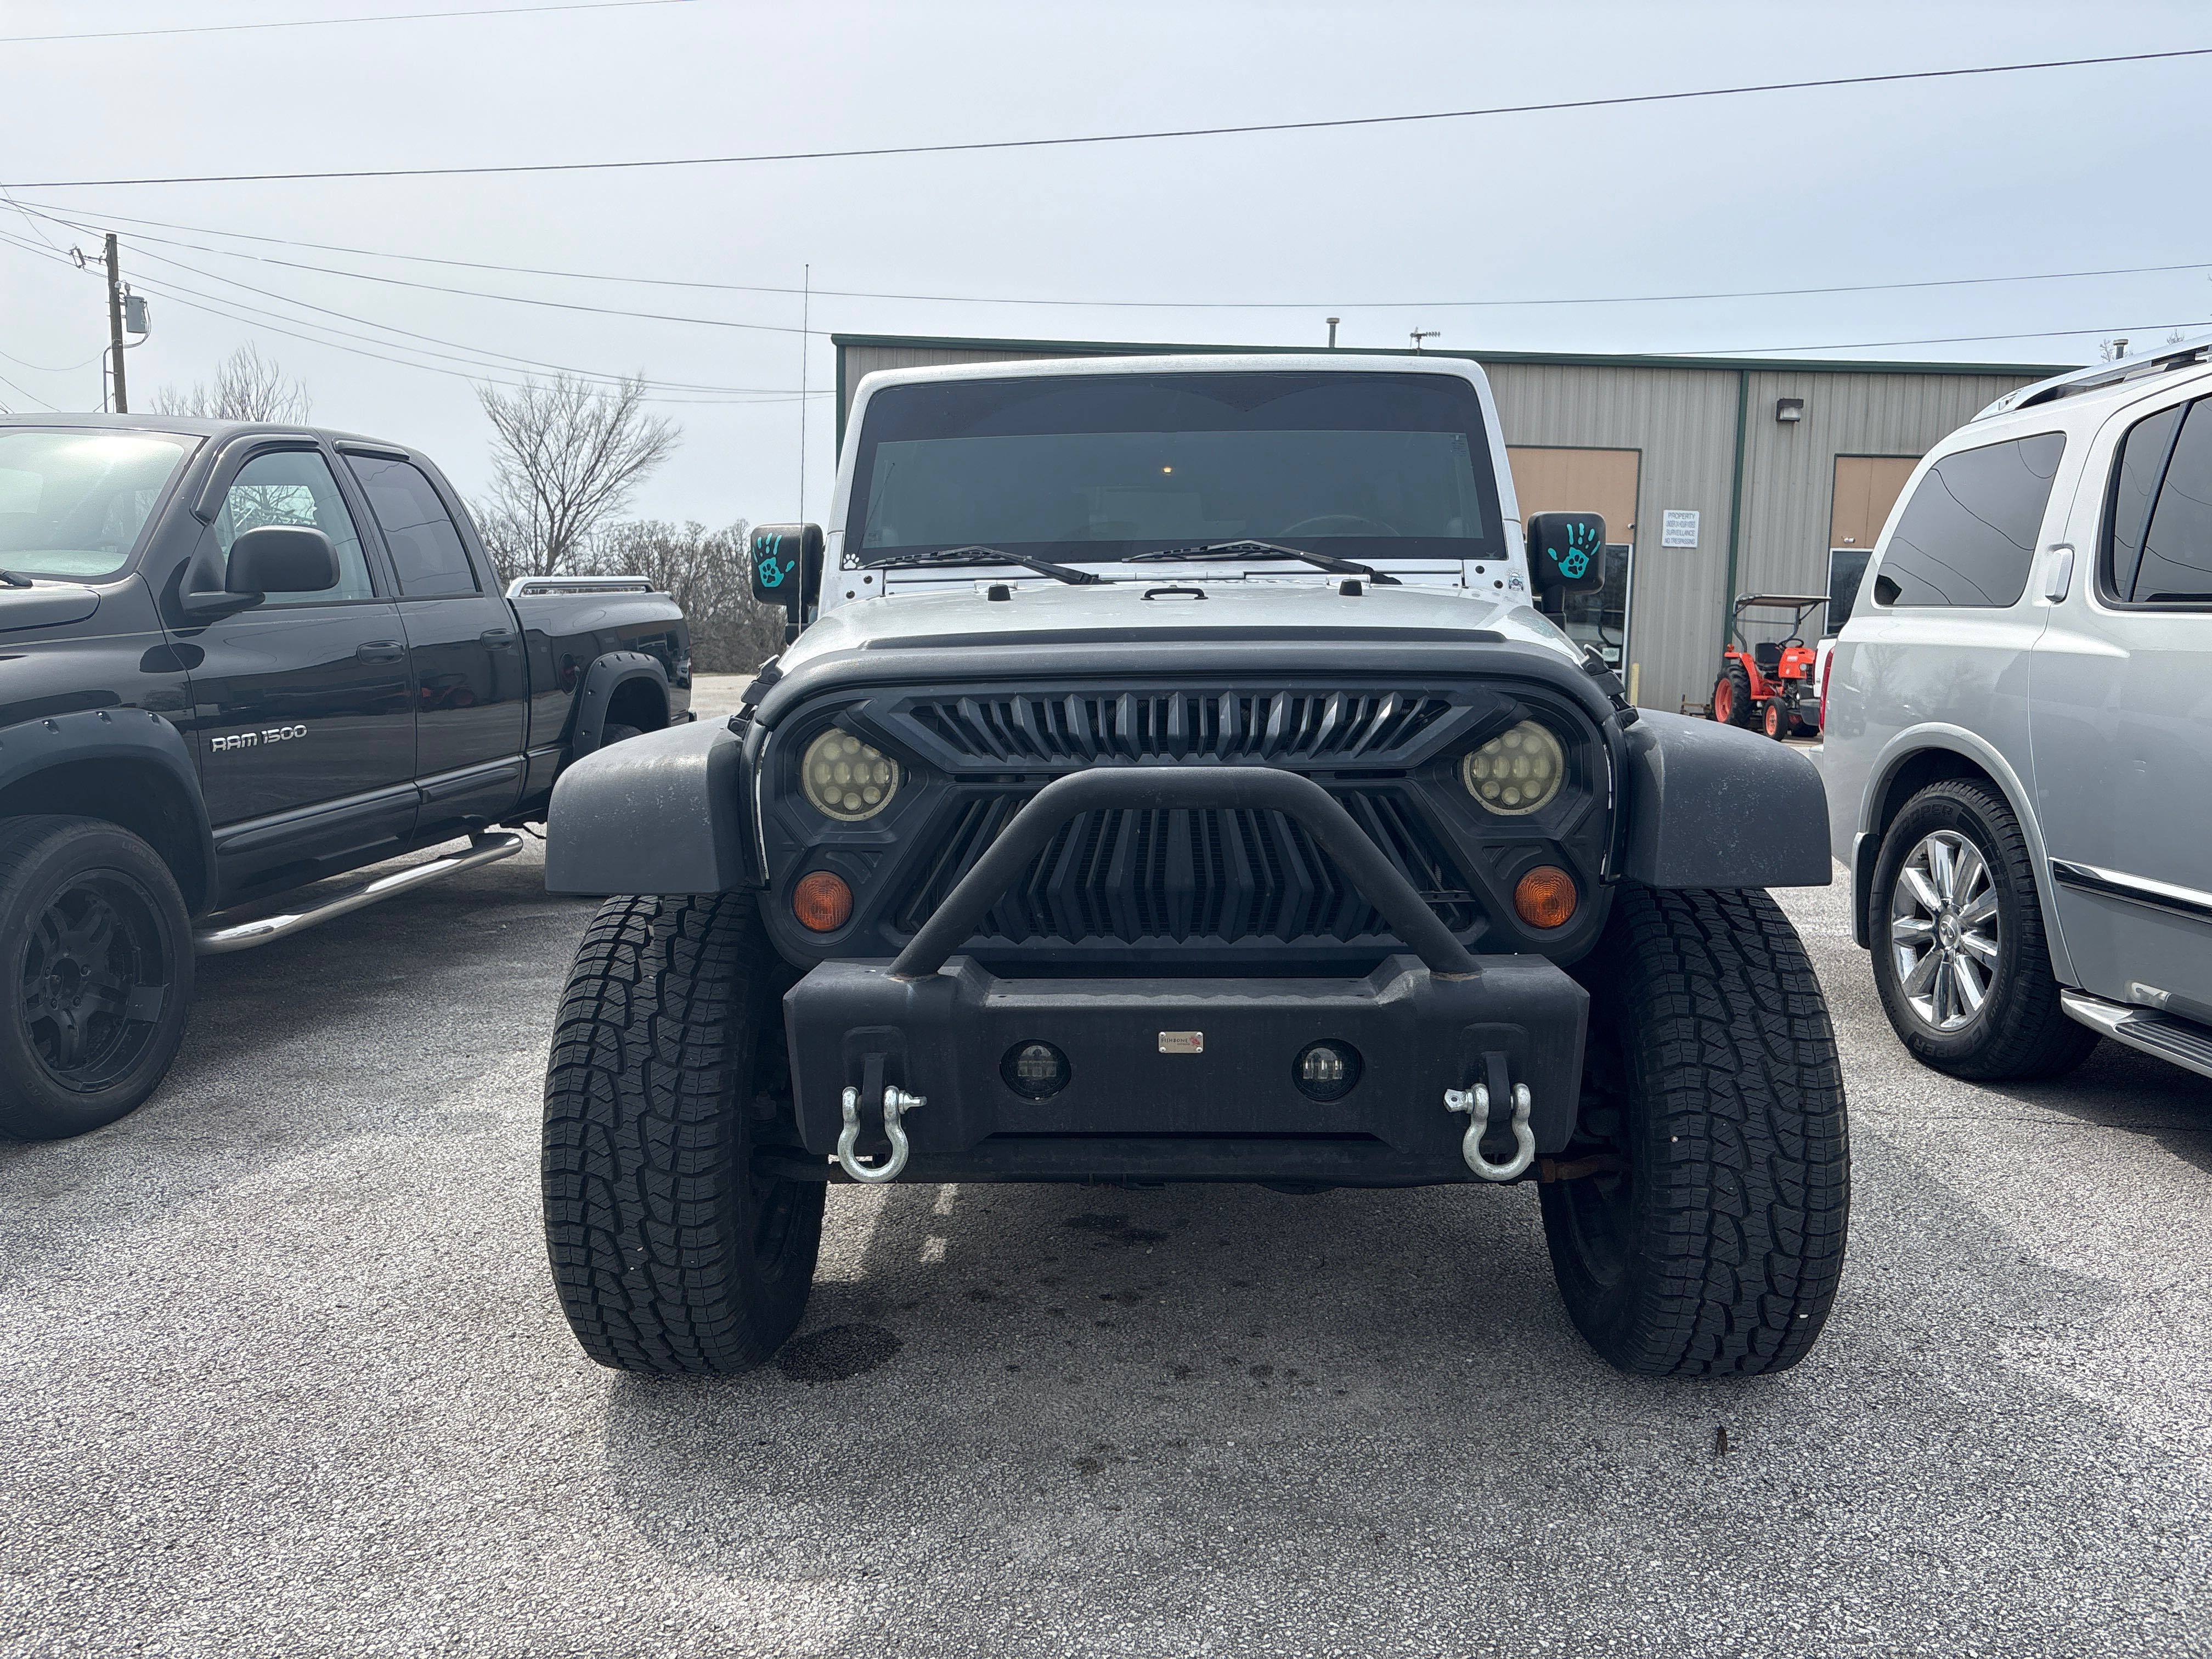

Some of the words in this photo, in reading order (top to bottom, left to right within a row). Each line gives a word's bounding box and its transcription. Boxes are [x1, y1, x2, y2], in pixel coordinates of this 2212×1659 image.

[1666, 528, 1696, 537] SURVEILLANCE
[210, 732, 258, 753] RAM
[260, 724, 308, 744] 1500
[1893, 803, 1954, 844] COOPER
